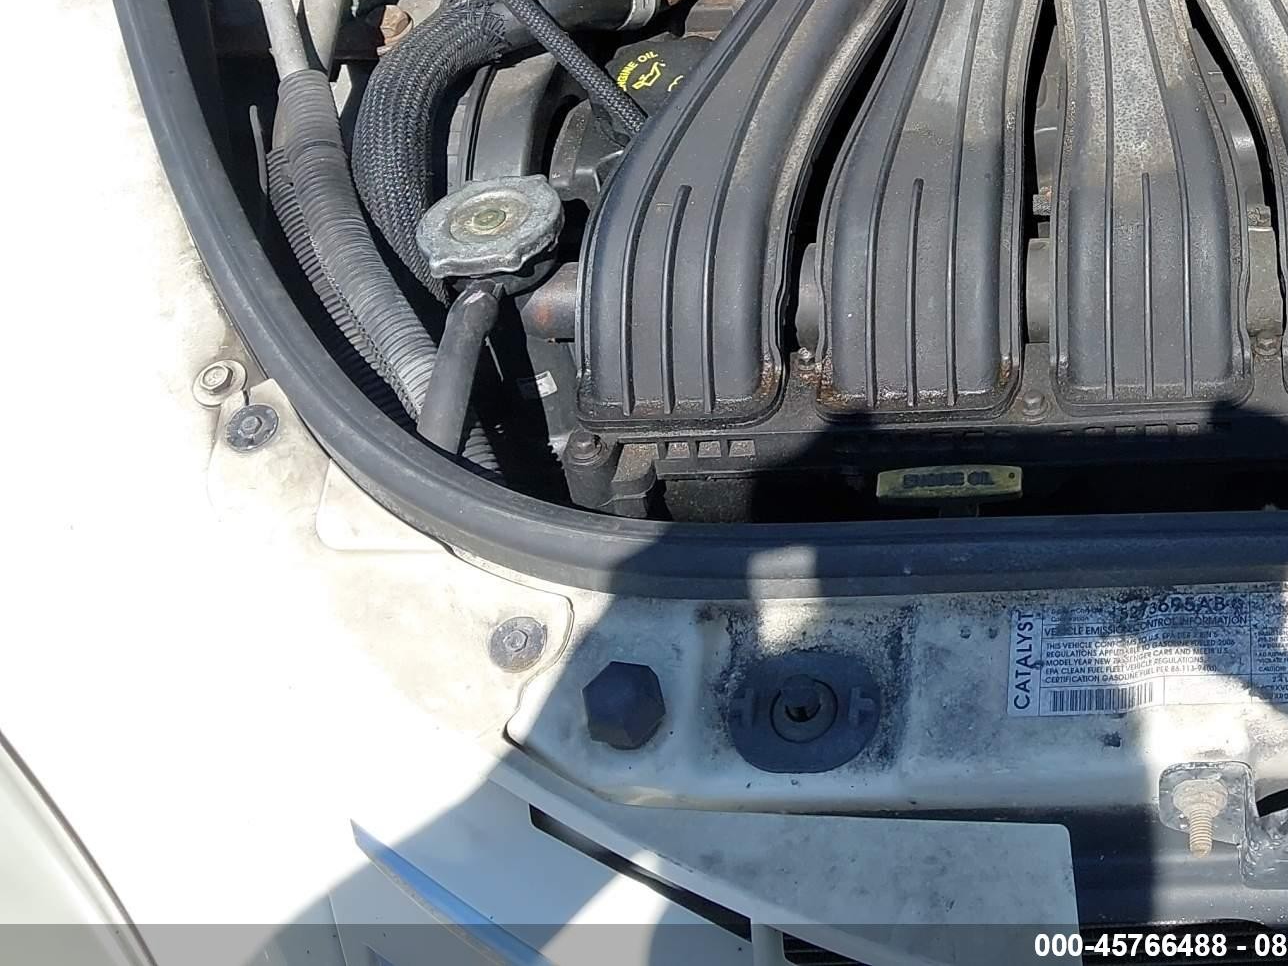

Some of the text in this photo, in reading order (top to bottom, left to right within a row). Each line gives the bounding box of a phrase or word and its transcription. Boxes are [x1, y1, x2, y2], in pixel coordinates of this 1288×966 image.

[617, 51, 659, 92] NGINE OIL
[1062, 641, 1092, 649] VEHICLE
[1013, 611, 1034, 710] CATALYST
[1047, 649, 1096, 658] REGULATIONS
[1106, 665, 1124, 673] FLEET
[1126, 660, 1153, 672] VEHICLE
[1045, 675, 1100, 683] CERTIFICATION
[1101, 672, 1138, 682] GASOLINE
[1138, 668, 1154, 677] FUEL
